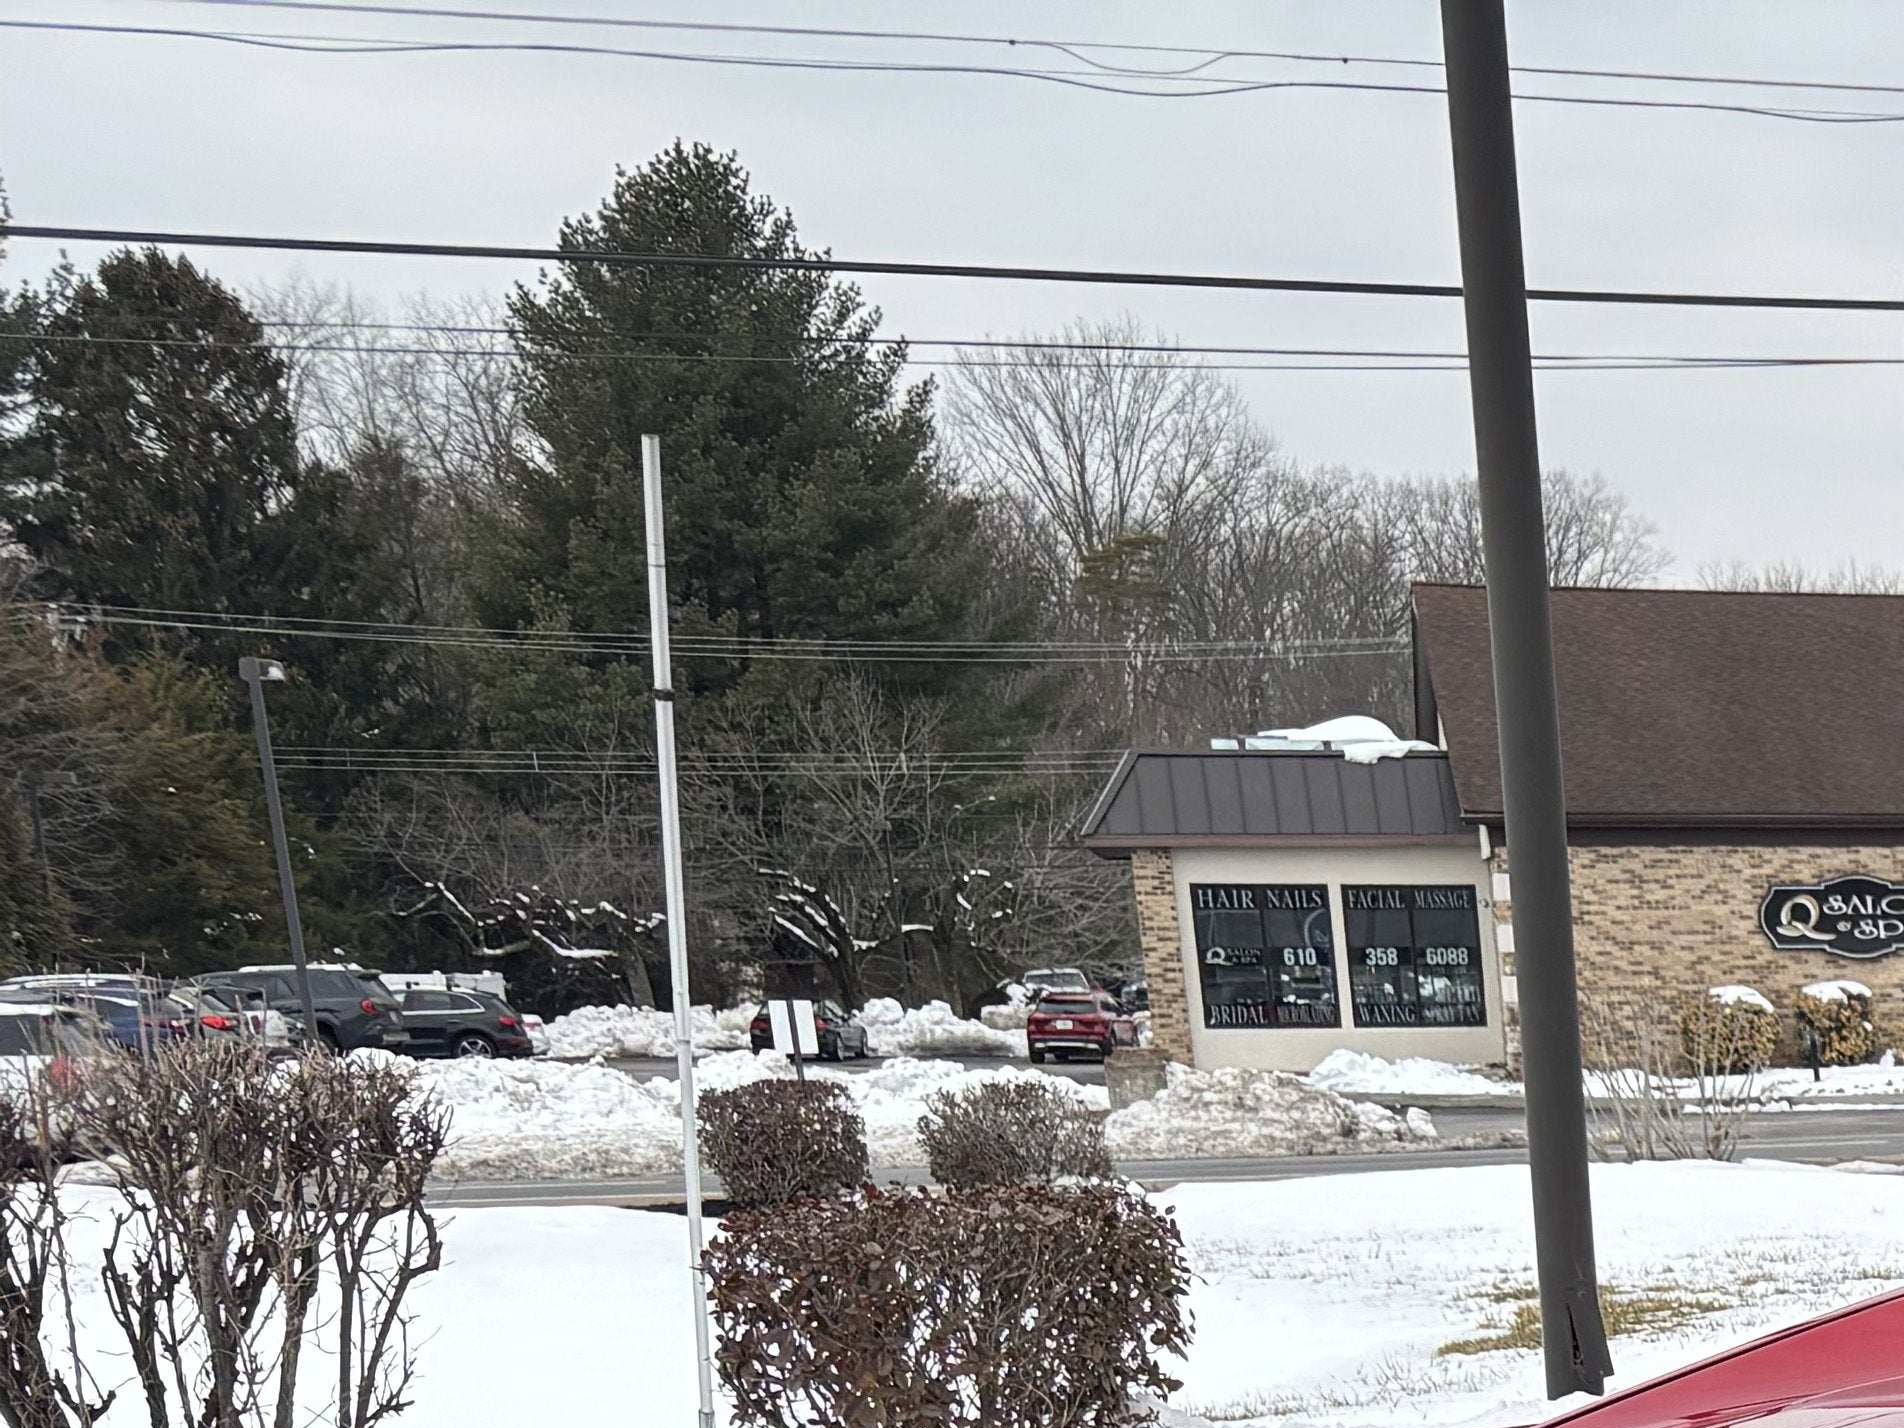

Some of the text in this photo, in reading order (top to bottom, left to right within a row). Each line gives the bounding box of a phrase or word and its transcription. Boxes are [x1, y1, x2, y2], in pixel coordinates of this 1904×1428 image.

[1198, 888, 1323, 909] HAIR NAILS
[1348, 889, 1471, 909] FACIAL MASSAGE
[1776, 895, 1837, 940] Q
[1205, 947, 1233, 966] Q
[1283, 948, 1317, 966] 610
[1365, 947, 1469, 965] 358 6088
[1210, 1005, 1268, 1024] BRIDAL
[1360, 1005, 1416, 1023] WAXING
